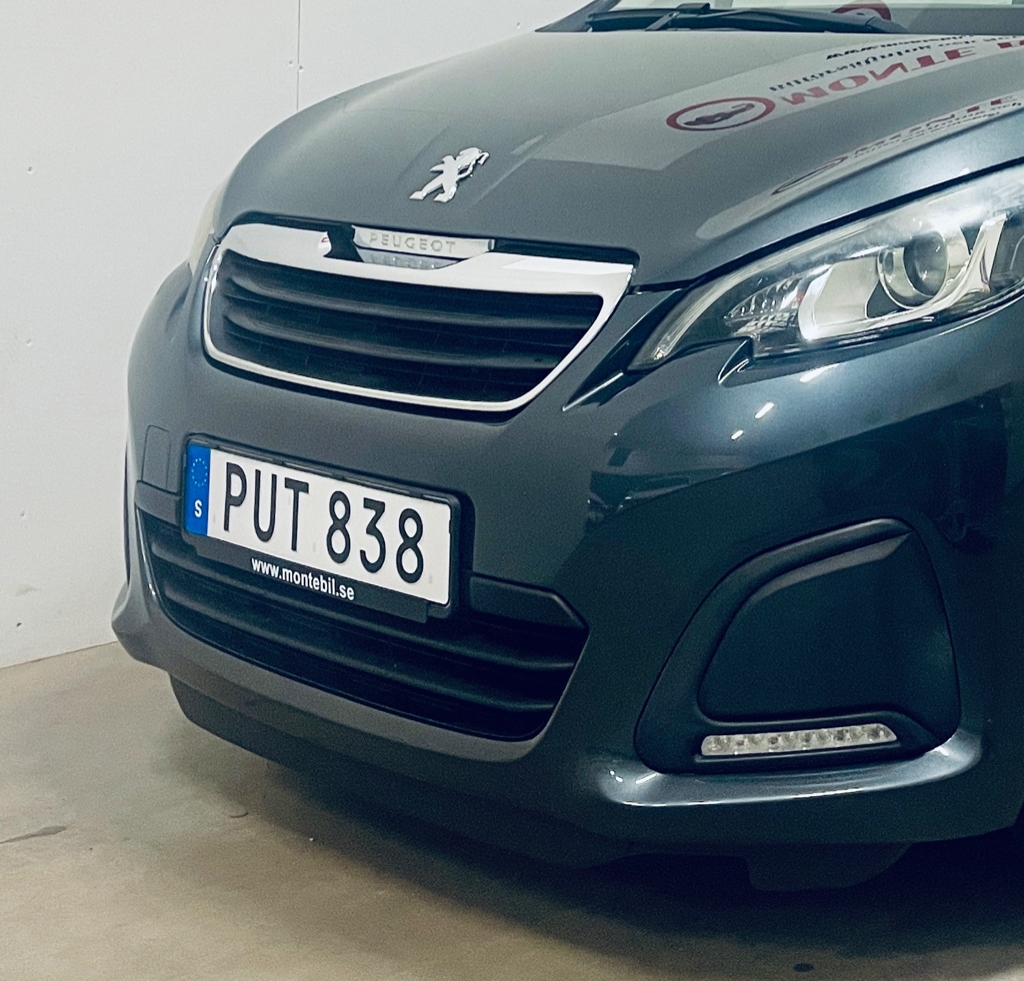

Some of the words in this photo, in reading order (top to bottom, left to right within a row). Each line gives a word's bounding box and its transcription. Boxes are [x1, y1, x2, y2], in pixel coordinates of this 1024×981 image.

[369, 226, 456, 254] PEUGEOT
[193, 499, 203, 518] S
[223, 461, 310, 552] PUT
[326, 490, 424, 584] 838
[251, 557, 355, 601] www.montebil.se
